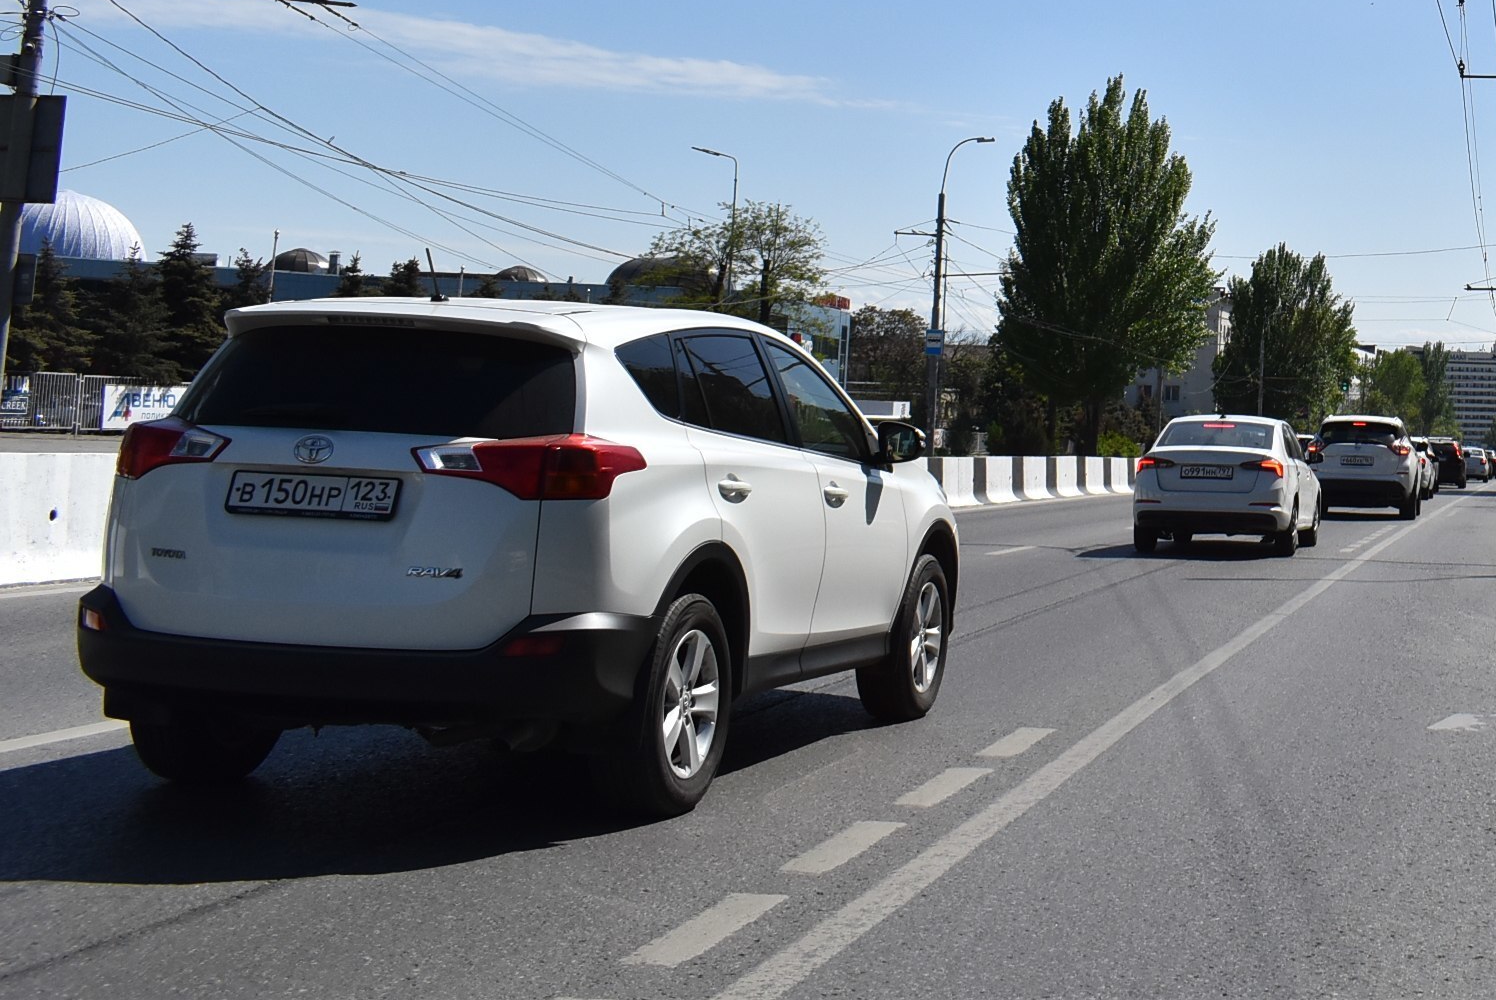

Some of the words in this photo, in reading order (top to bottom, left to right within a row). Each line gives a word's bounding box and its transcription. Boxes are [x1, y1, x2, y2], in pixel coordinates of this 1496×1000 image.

[350, 480, 388, 502] 123
[353, 501, 375, 511] RUS
[406, 566, 464, 579] RAV4
